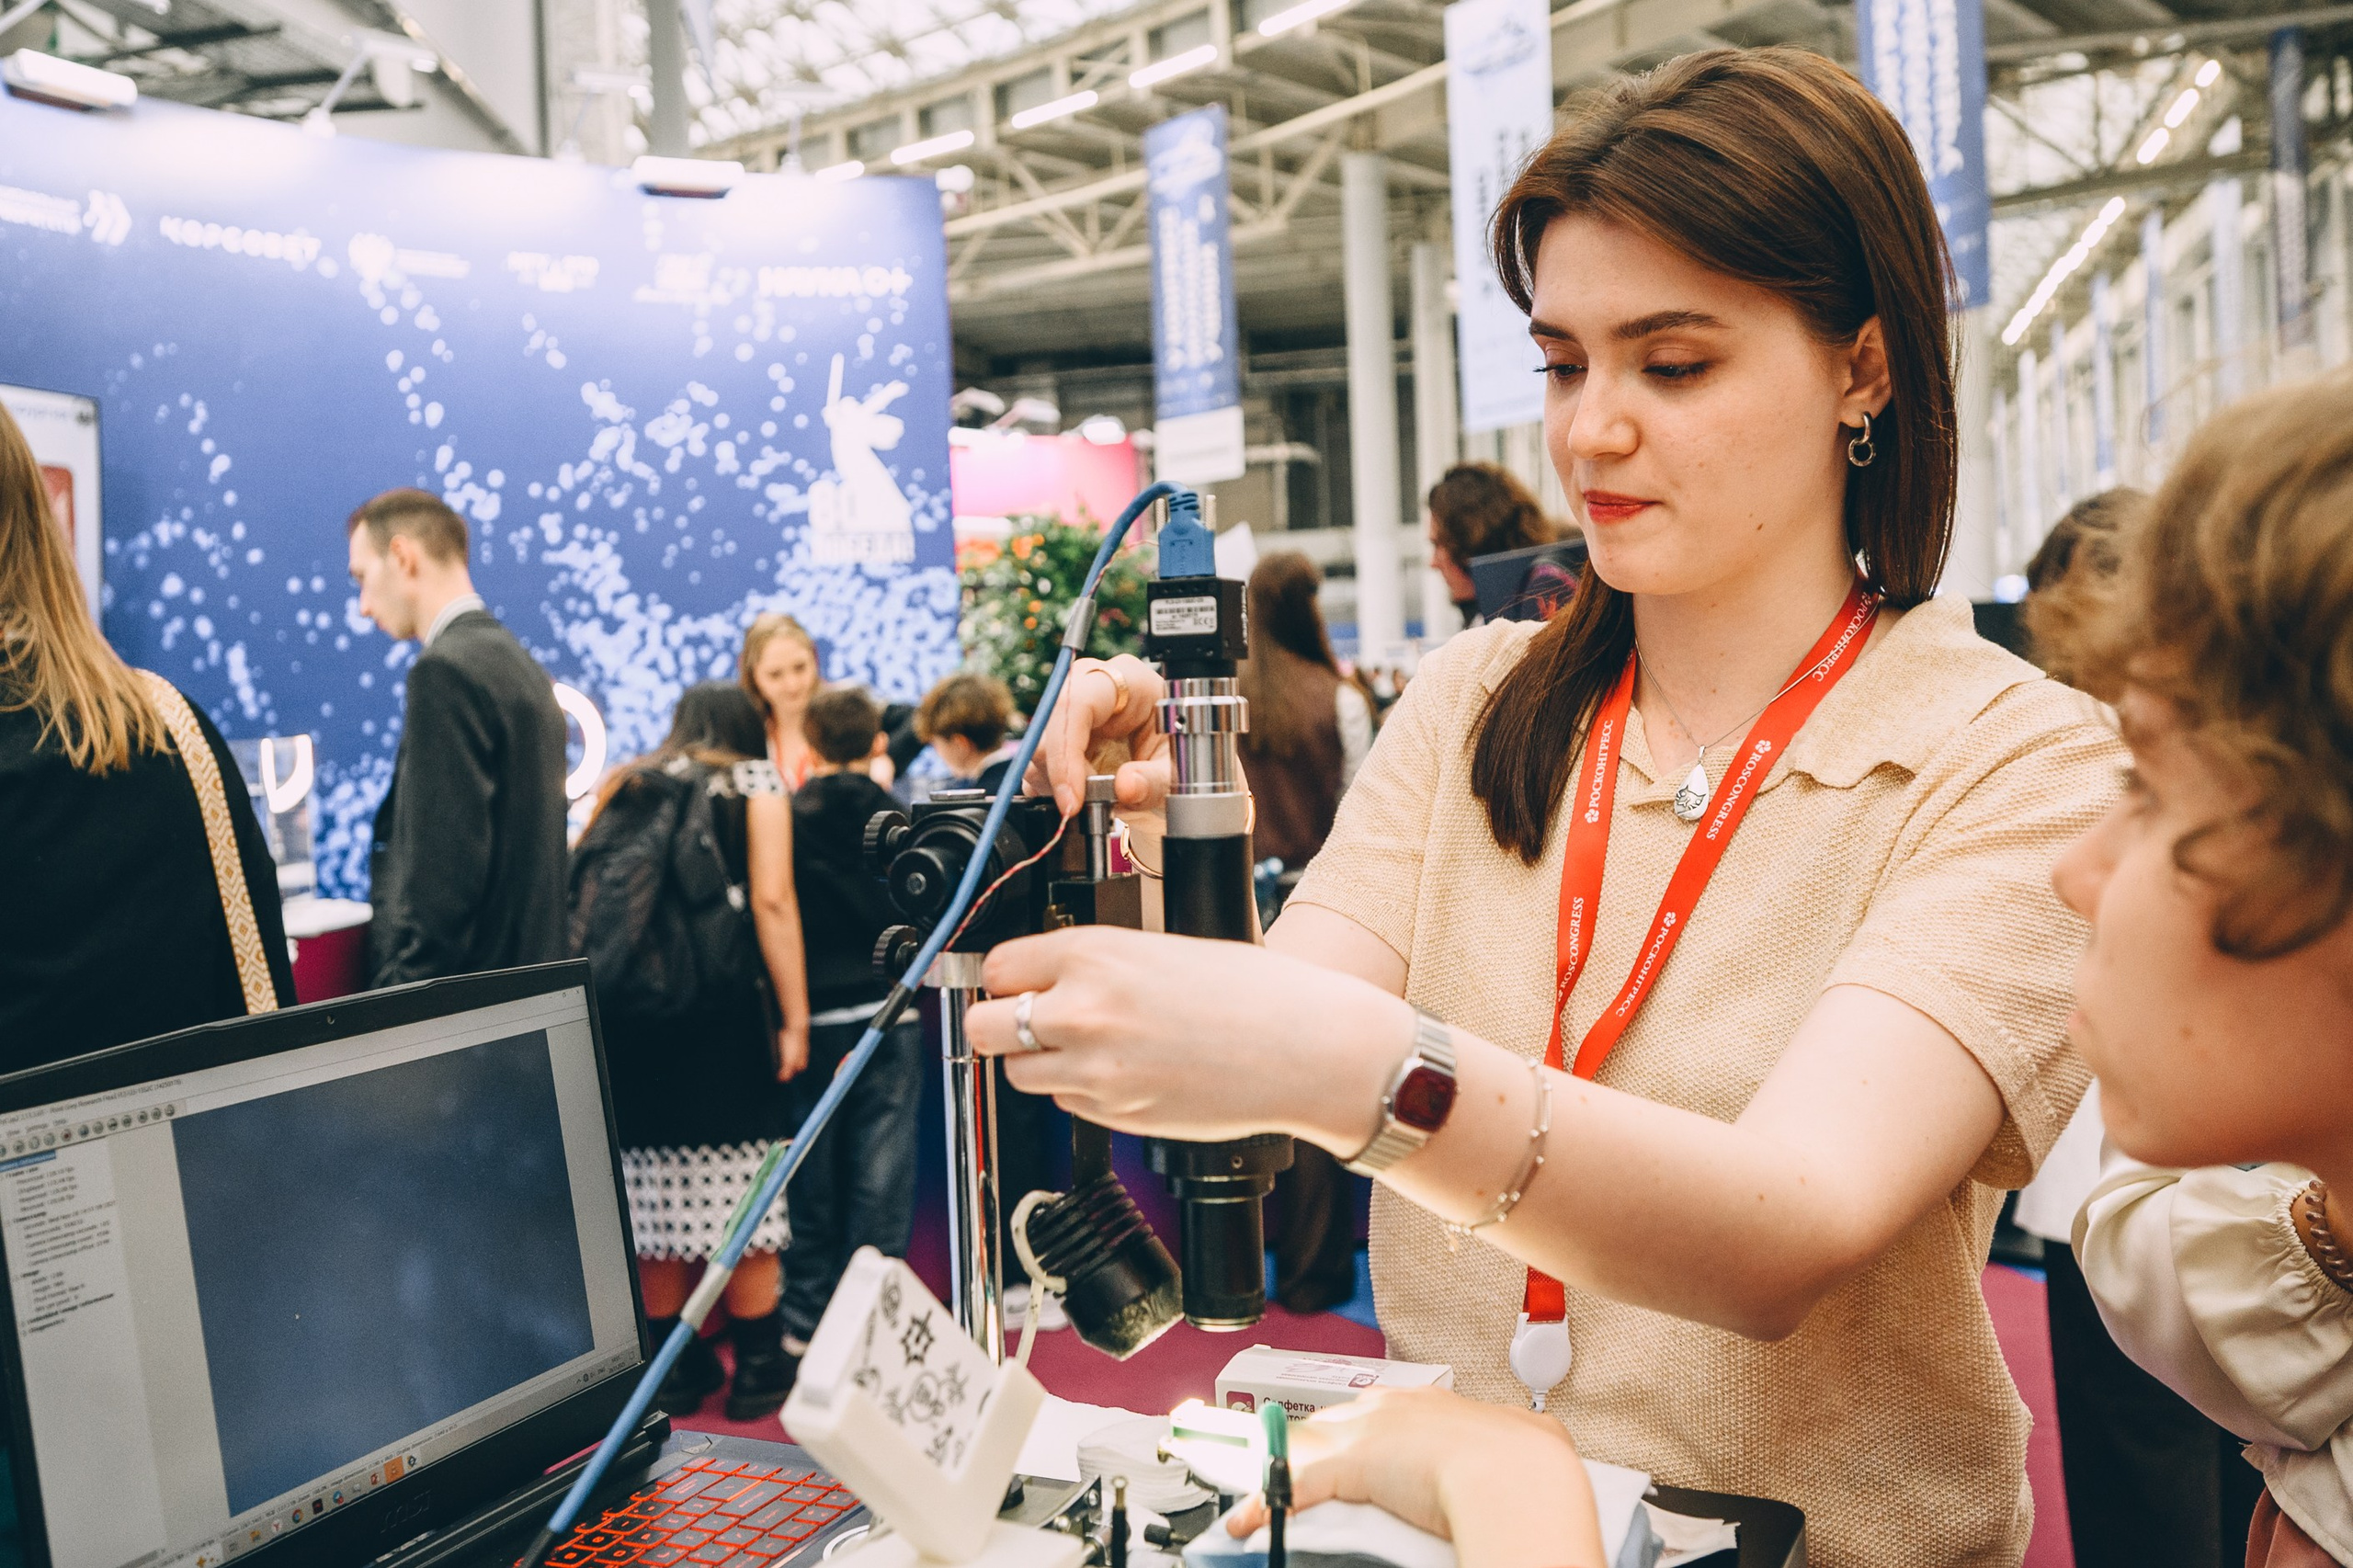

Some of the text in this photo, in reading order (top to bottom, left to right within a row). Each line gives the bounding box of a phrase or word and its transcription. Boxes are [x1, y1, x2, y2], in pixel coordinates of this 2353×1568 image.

[1588, 720, 1614, 808] РОСКОНГРЕСС
[1706, 752, 1763, 841] ROSCONGRESS
[1560, 896, 1585, 989] ROSCONGRESS
[1615, 926, 1669, 1017] РОСКОНГРЕСС
[1263, 1396, 1316, 1414] Слфетка
